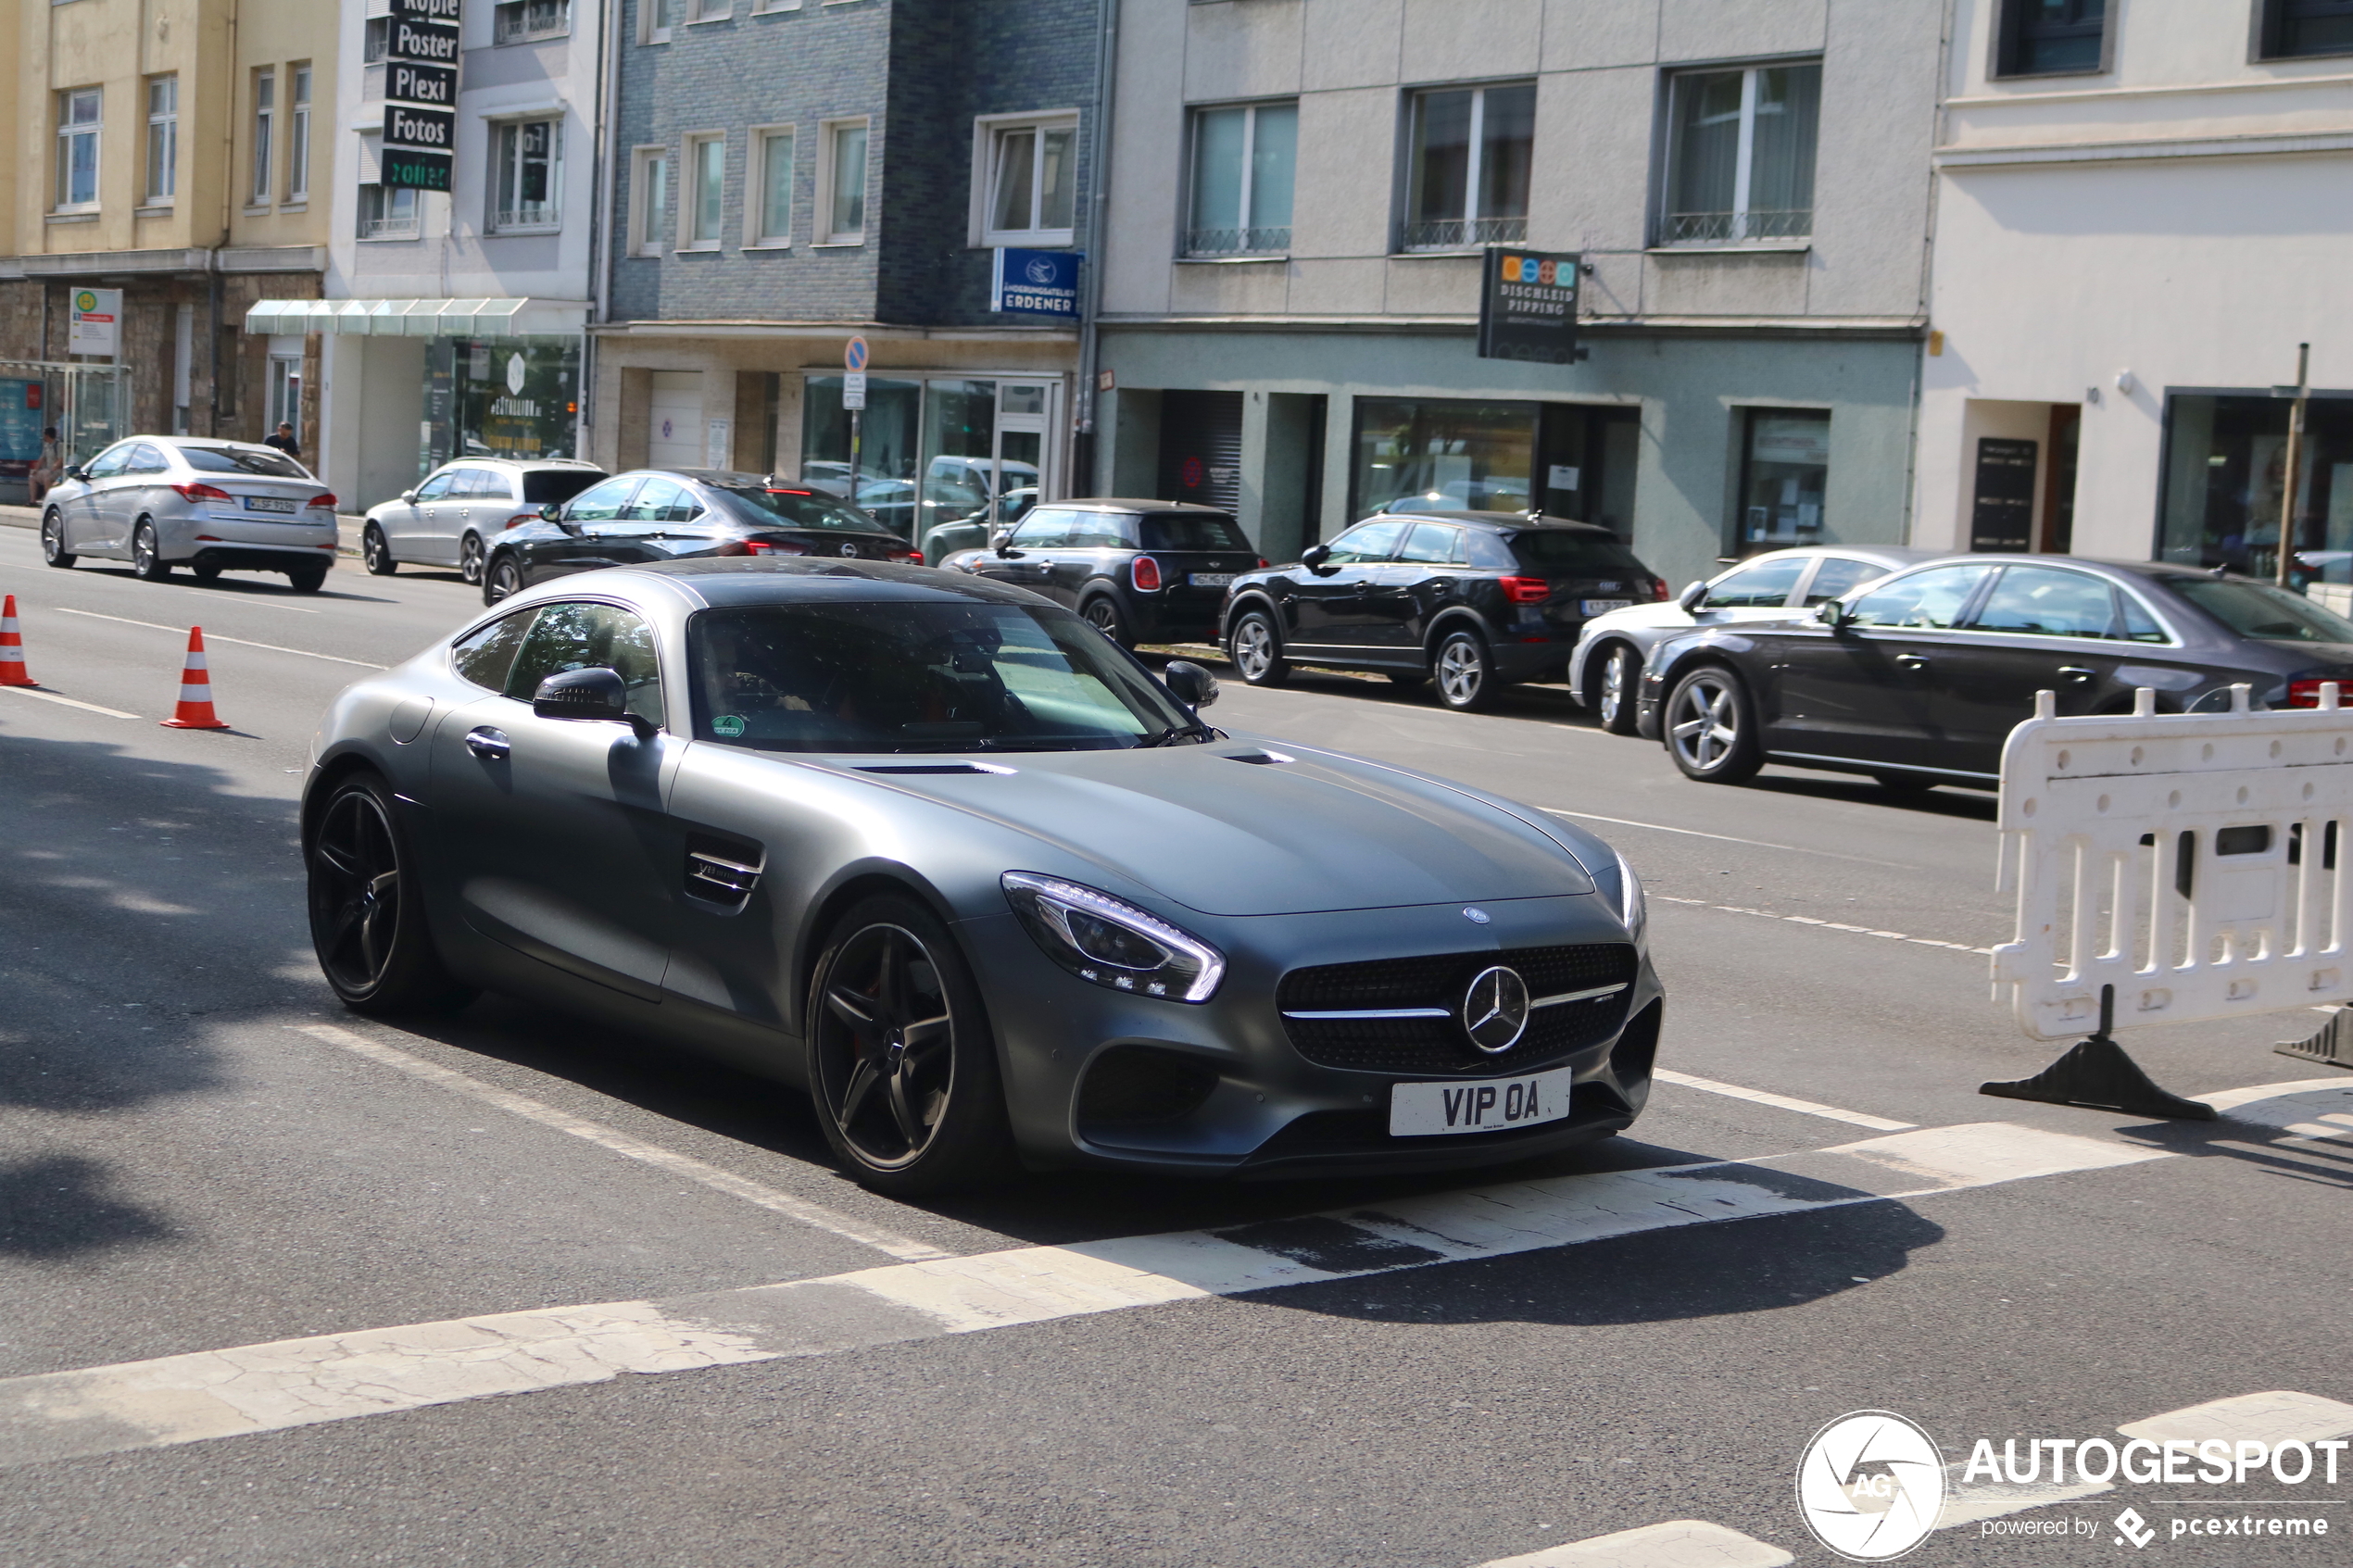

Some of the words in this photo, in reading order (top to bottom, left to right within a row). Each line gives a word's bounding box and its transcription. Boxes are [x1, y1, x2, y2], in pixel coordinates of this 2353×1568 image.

[397, 24, 457, 58] Poster
[396, 68, 447, 101] Plexi
[394, 110, 445, 144] Fotos
[1501, 284, 1574, 302] DISCHLEID
[1005, 294, 1071, 311] ERDENER
[1508, 299, 1565, 315] PIPPING
[723, 716, 732, 727] 4
